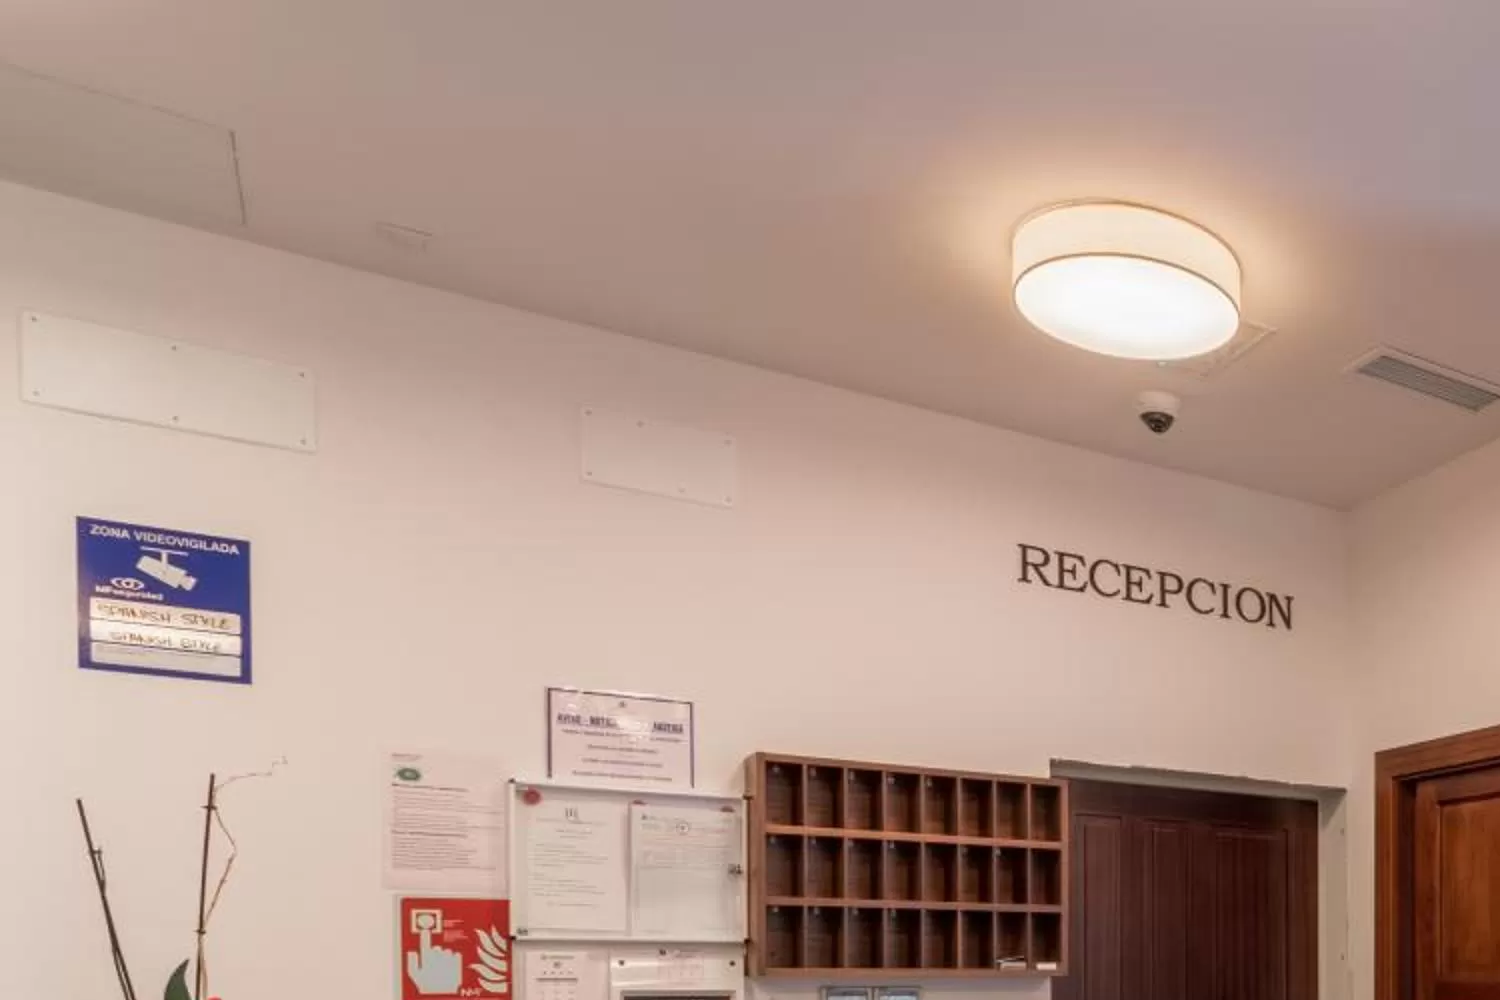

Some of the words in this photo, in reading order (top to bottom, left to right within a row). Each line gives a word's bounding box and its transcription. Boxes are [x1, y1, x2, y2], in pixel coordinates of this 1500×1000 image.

[89, 524, 131, 540] ZONA
[133, 531, 241, 556] VIDEOVIGILADA
[1017, 543, 1295, 630] RECEPCION
